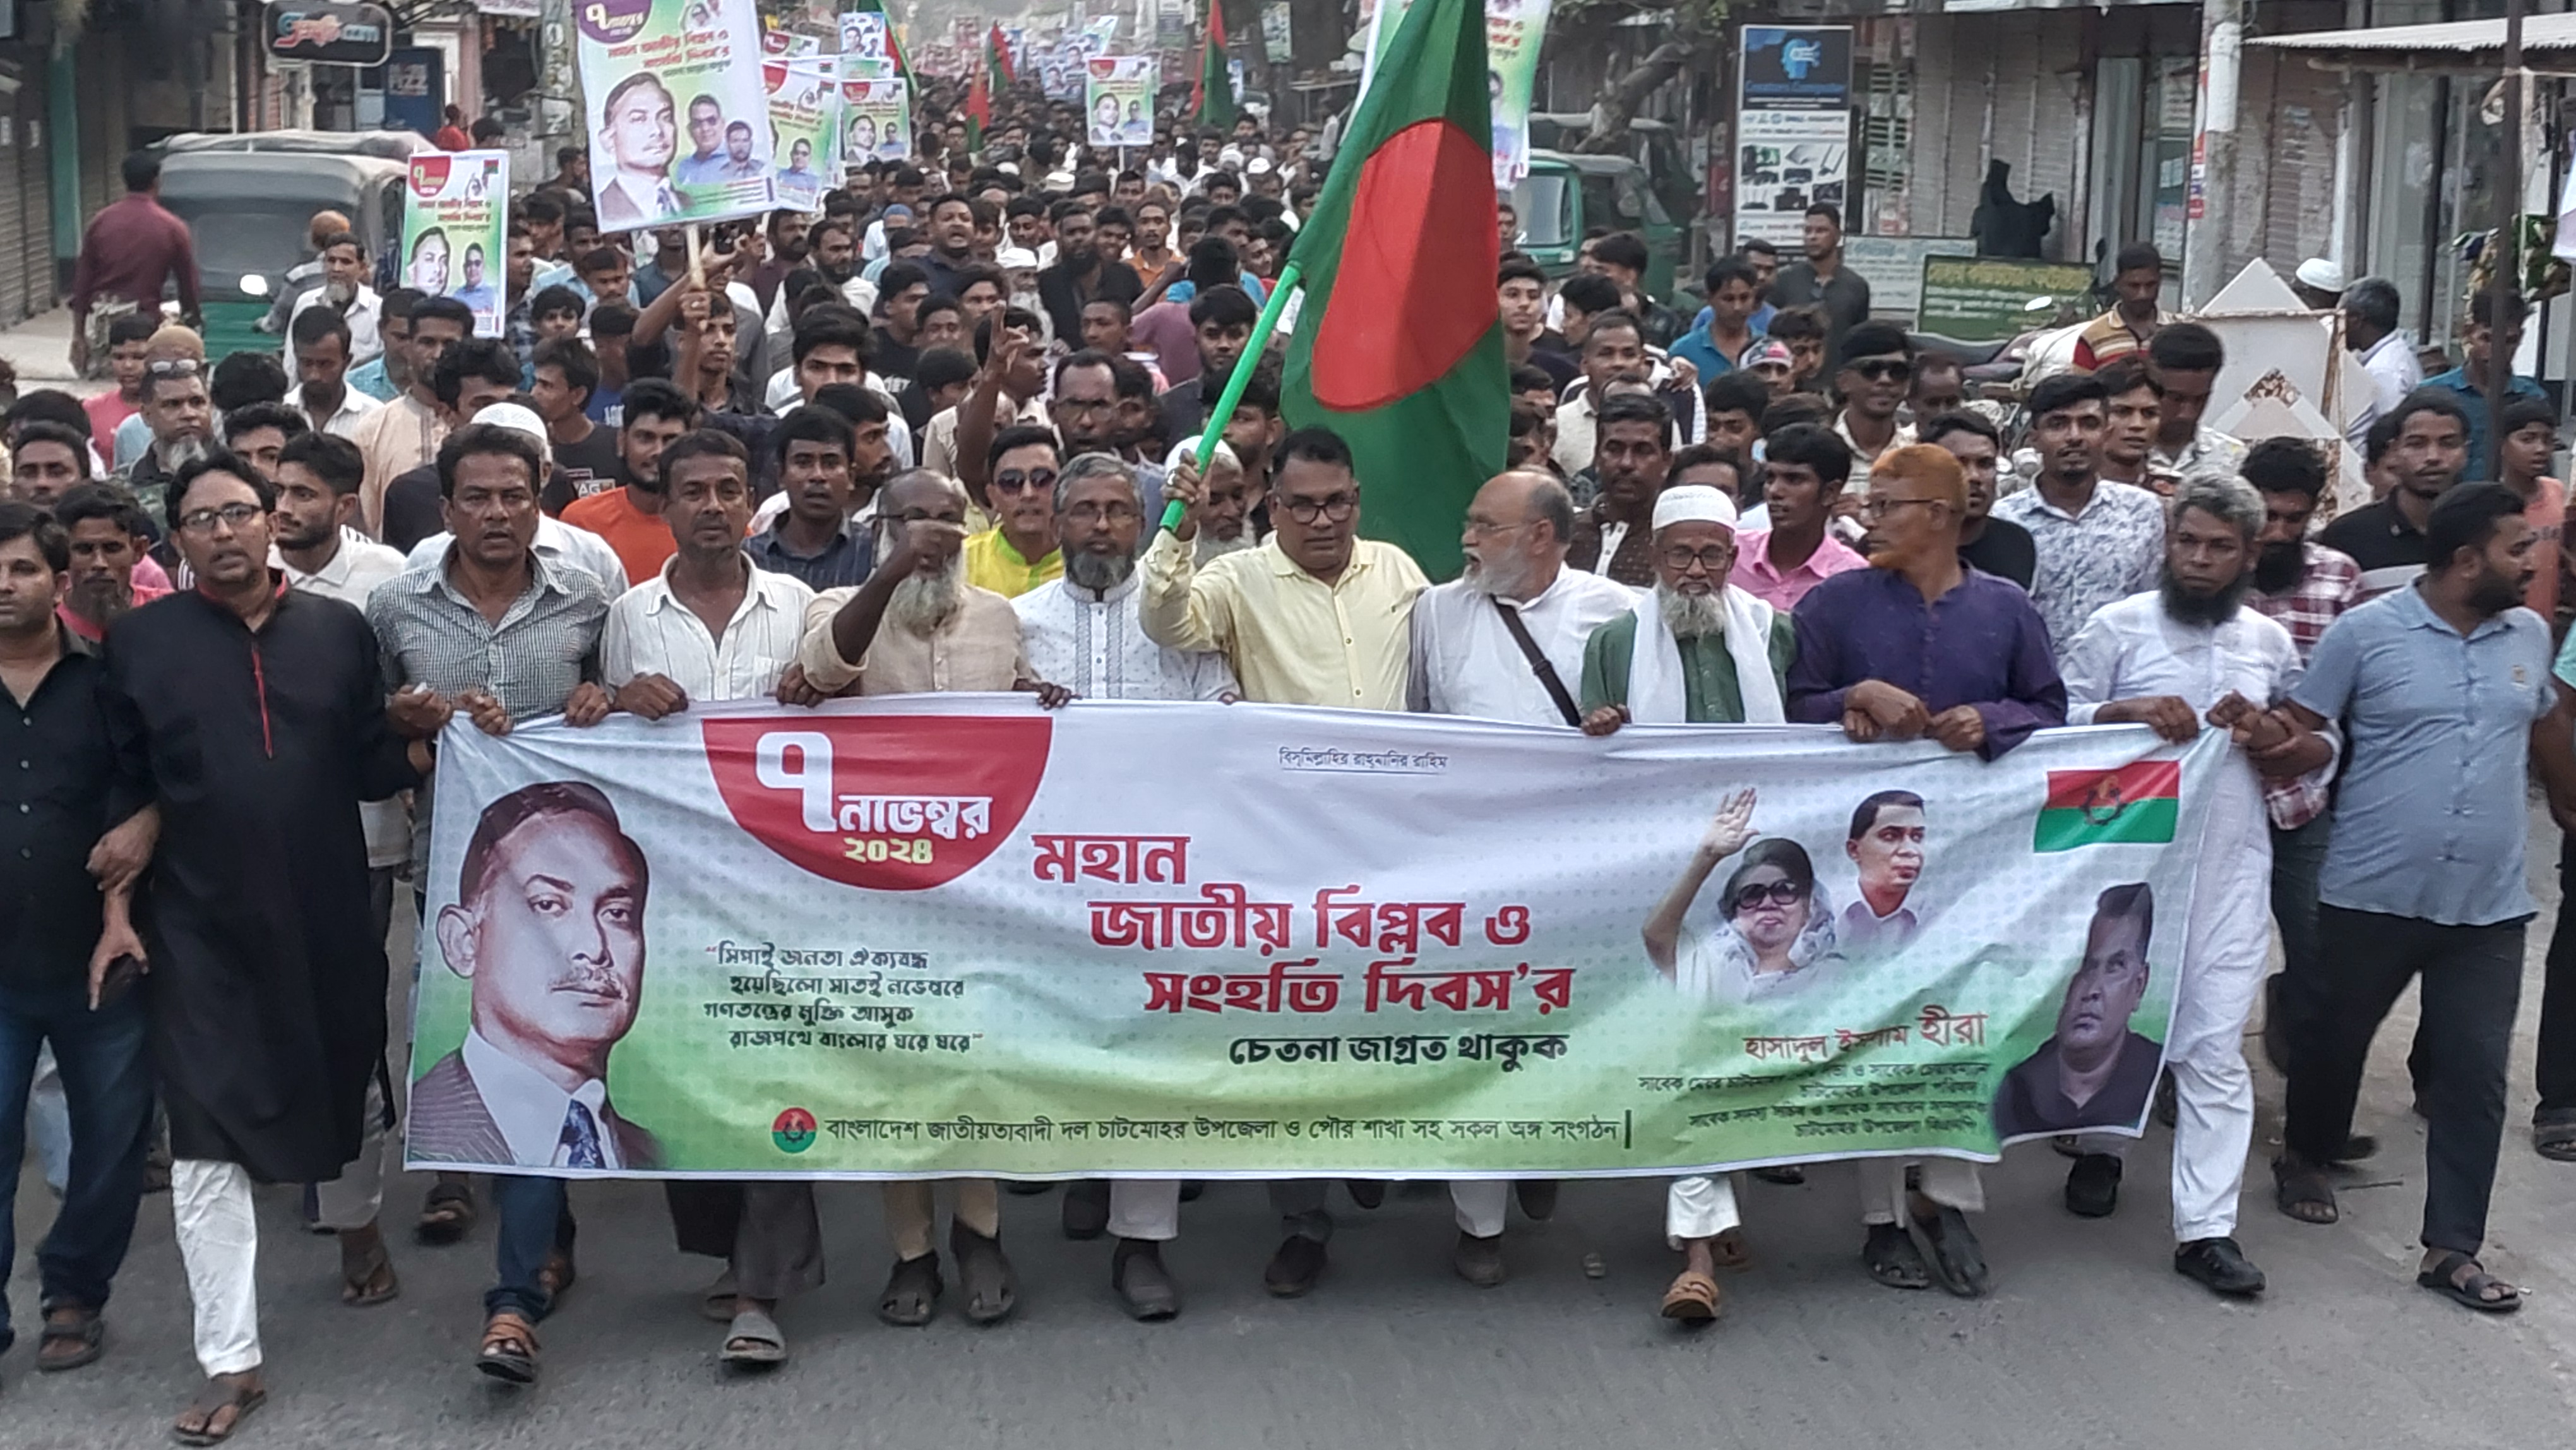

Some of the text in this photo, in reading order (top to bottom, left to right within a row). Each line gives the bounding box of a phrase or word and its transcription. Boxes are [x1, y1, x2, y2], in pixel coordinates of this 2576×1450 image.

[756, 731, 993, 839] ৭ নভেম্বর
[844, 838, 934, 864] ২০২৪
[1032, 835, 1191, 884] মহান
[1087, 882, 1531, 956] জাতীয় বিপ্লব ও
[780, 949, 844, 967] জনতা
[730, 969, 965, 998] হয়েছিলো সাতই নভেম্বরে
[1143, 957, 1344, 1014] সংহতি
[797, 998, 845, 1026] মুক্তি
[850, 1005, 915, 1029] আসুক
[1915, 1004, 1989, 1047] হীরা
[729, 1030, 812, 1050] রাজপথে
[818, 1032, 888, 1052] বাংলার
[894, 1033, 930, 1053] ঘরে
[1229, 1034, 1571, 1073] চেতনা জাগ্রত থাকুক
[825, 1114, 1621, 1142] বাংলাদেশ জাতীয়তাবাদী দল চাটমোহর উপজেলা ও পৌর শাখা সহ সকল অঙ্গ সংগঠন
